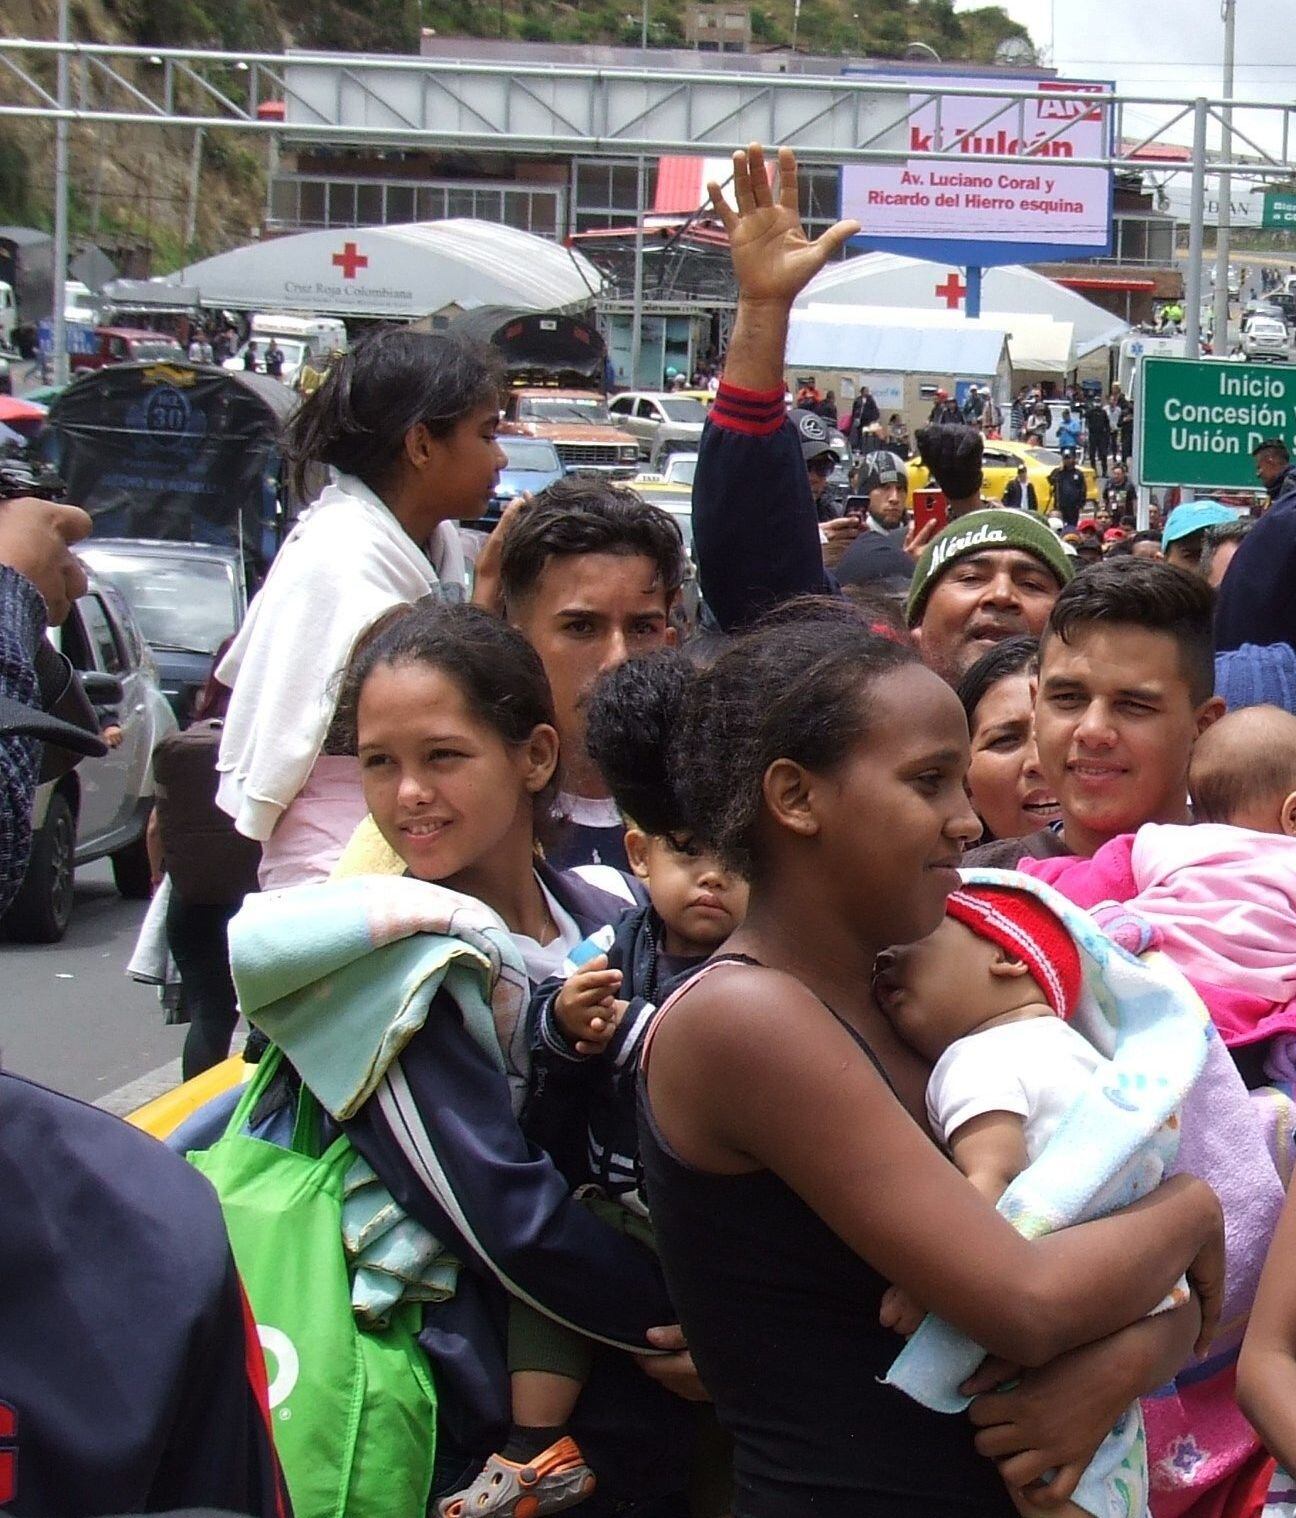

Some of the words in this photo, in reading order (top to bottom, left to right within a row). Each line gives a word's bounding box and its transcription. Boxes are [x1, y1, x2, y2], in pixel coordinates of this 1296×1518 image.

[901, 172, 924, 185] Av.
[930, 173, 993, 188] Luciano
[998, 176, 1040, 190] Coral
[1045, 179, 1054, 193] y
[868, 191, 930, 206] Ricardo
[935, 194, 960, 207] del
[965, 194, 1015, 209] Hierro
[1020, 199, 1084, 214] esquina
[1208, 201, 1248, 215] DAN
[285, 282, 312, 294] Cruz
[316, 283, 342, 297] Roja
[344, 285, 413, 300] Colombiana
[1220, 373, 1285, 397] Inicio
[1165, 399, 1286, 427] Concesión
[1171, 428, 1239, 454] Unión
[927, 524, 1008, 576] Mérida
